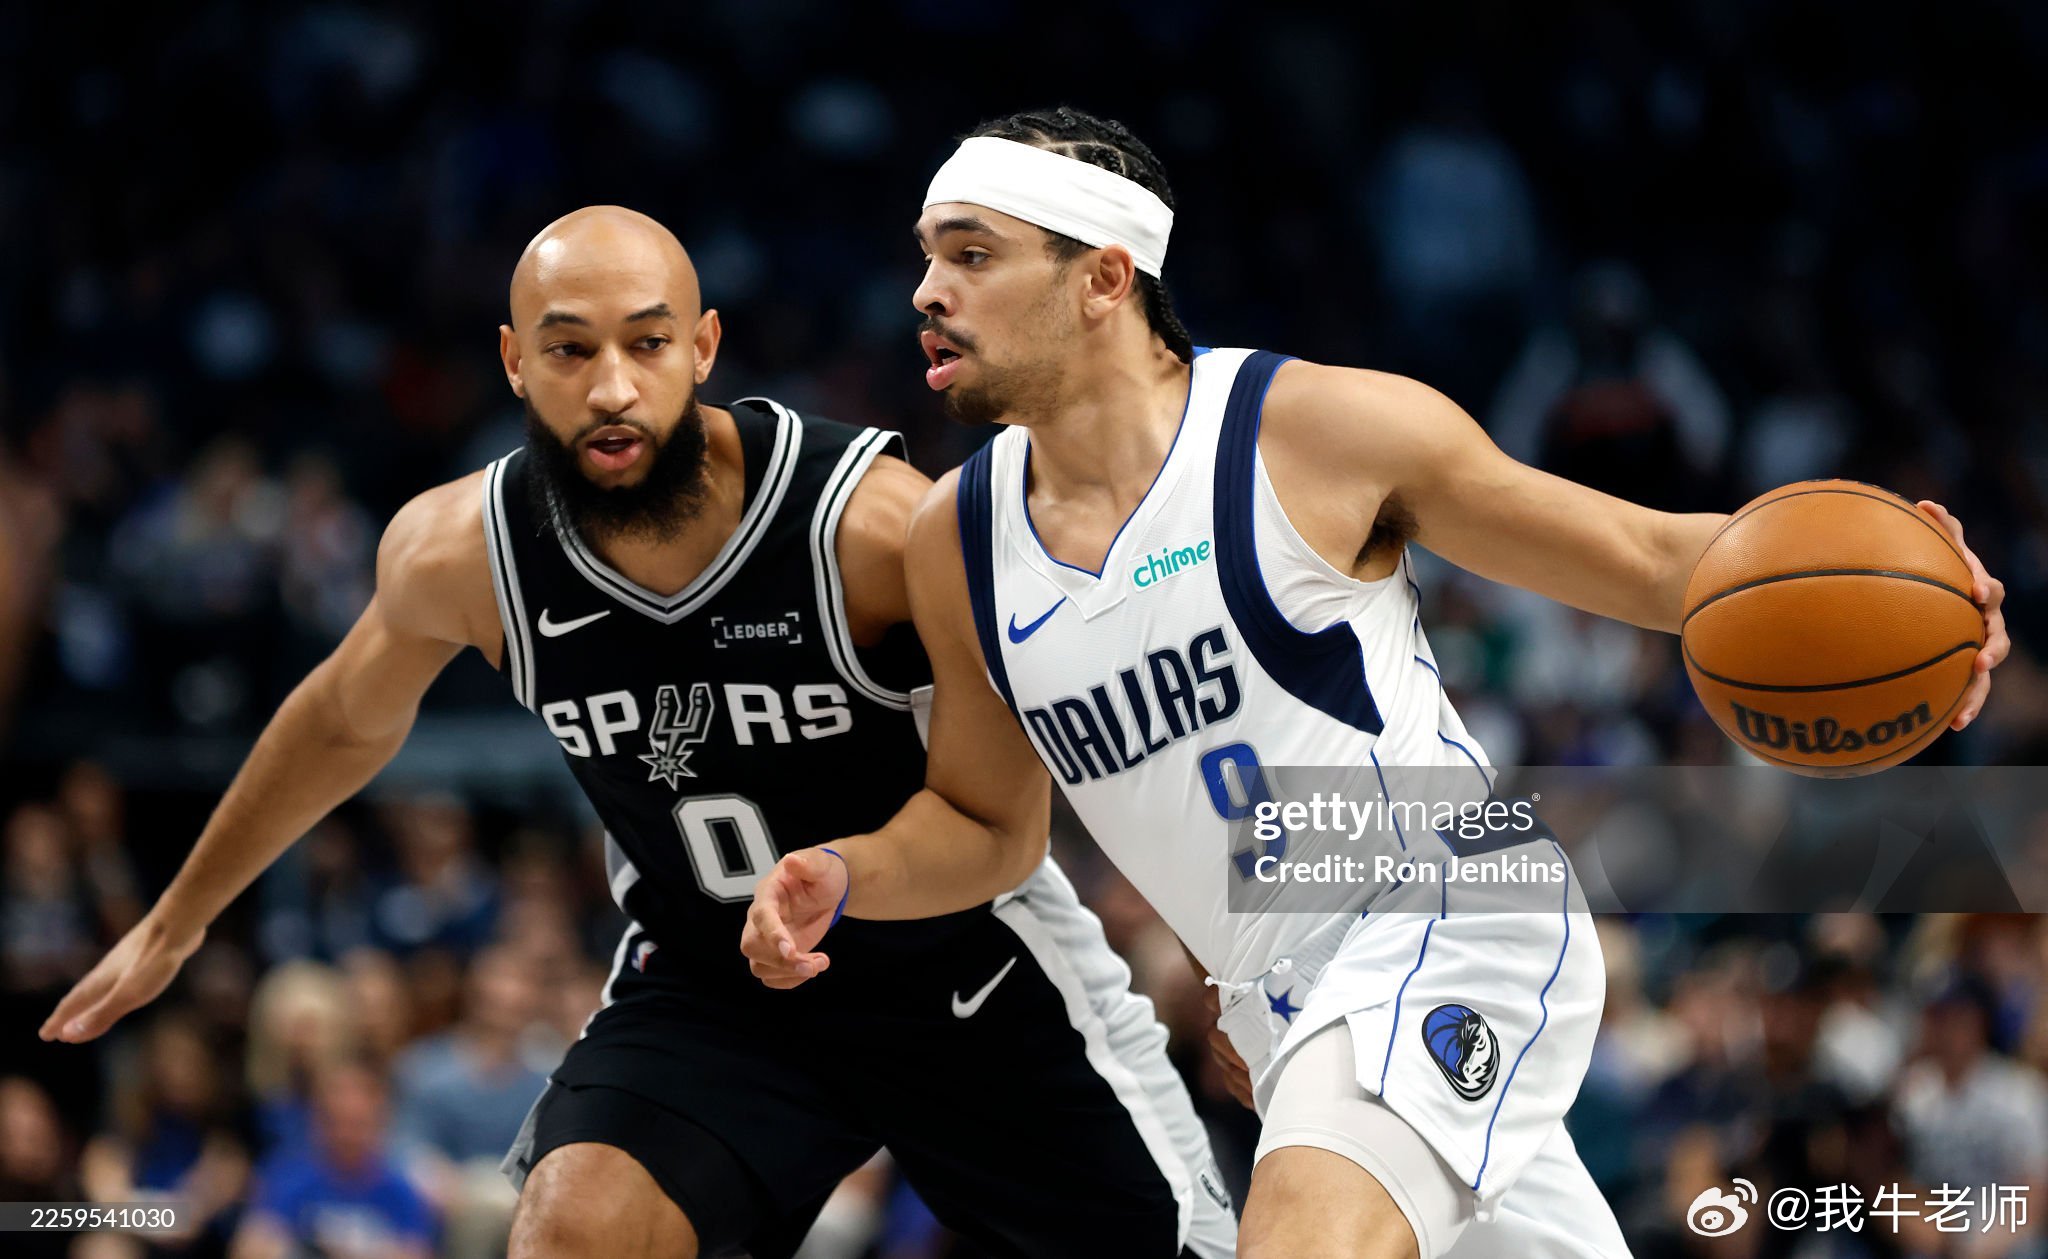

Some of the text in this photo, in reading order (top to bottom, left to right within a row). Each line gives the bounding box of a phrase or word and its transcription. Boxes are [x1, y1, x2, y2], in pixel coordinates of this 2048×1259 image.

[1132, 540, 1211, 588] chime
[722, 621, 790, 641] LEDGER
[541, 682, 853, 791] SPURS
[1021, 624, 1244, 786] DALLAS
[1730, 701, 1932, 754] Wilson
[671, 793, 781, 904] 0
[1199, 740, 1291, 884] 9
